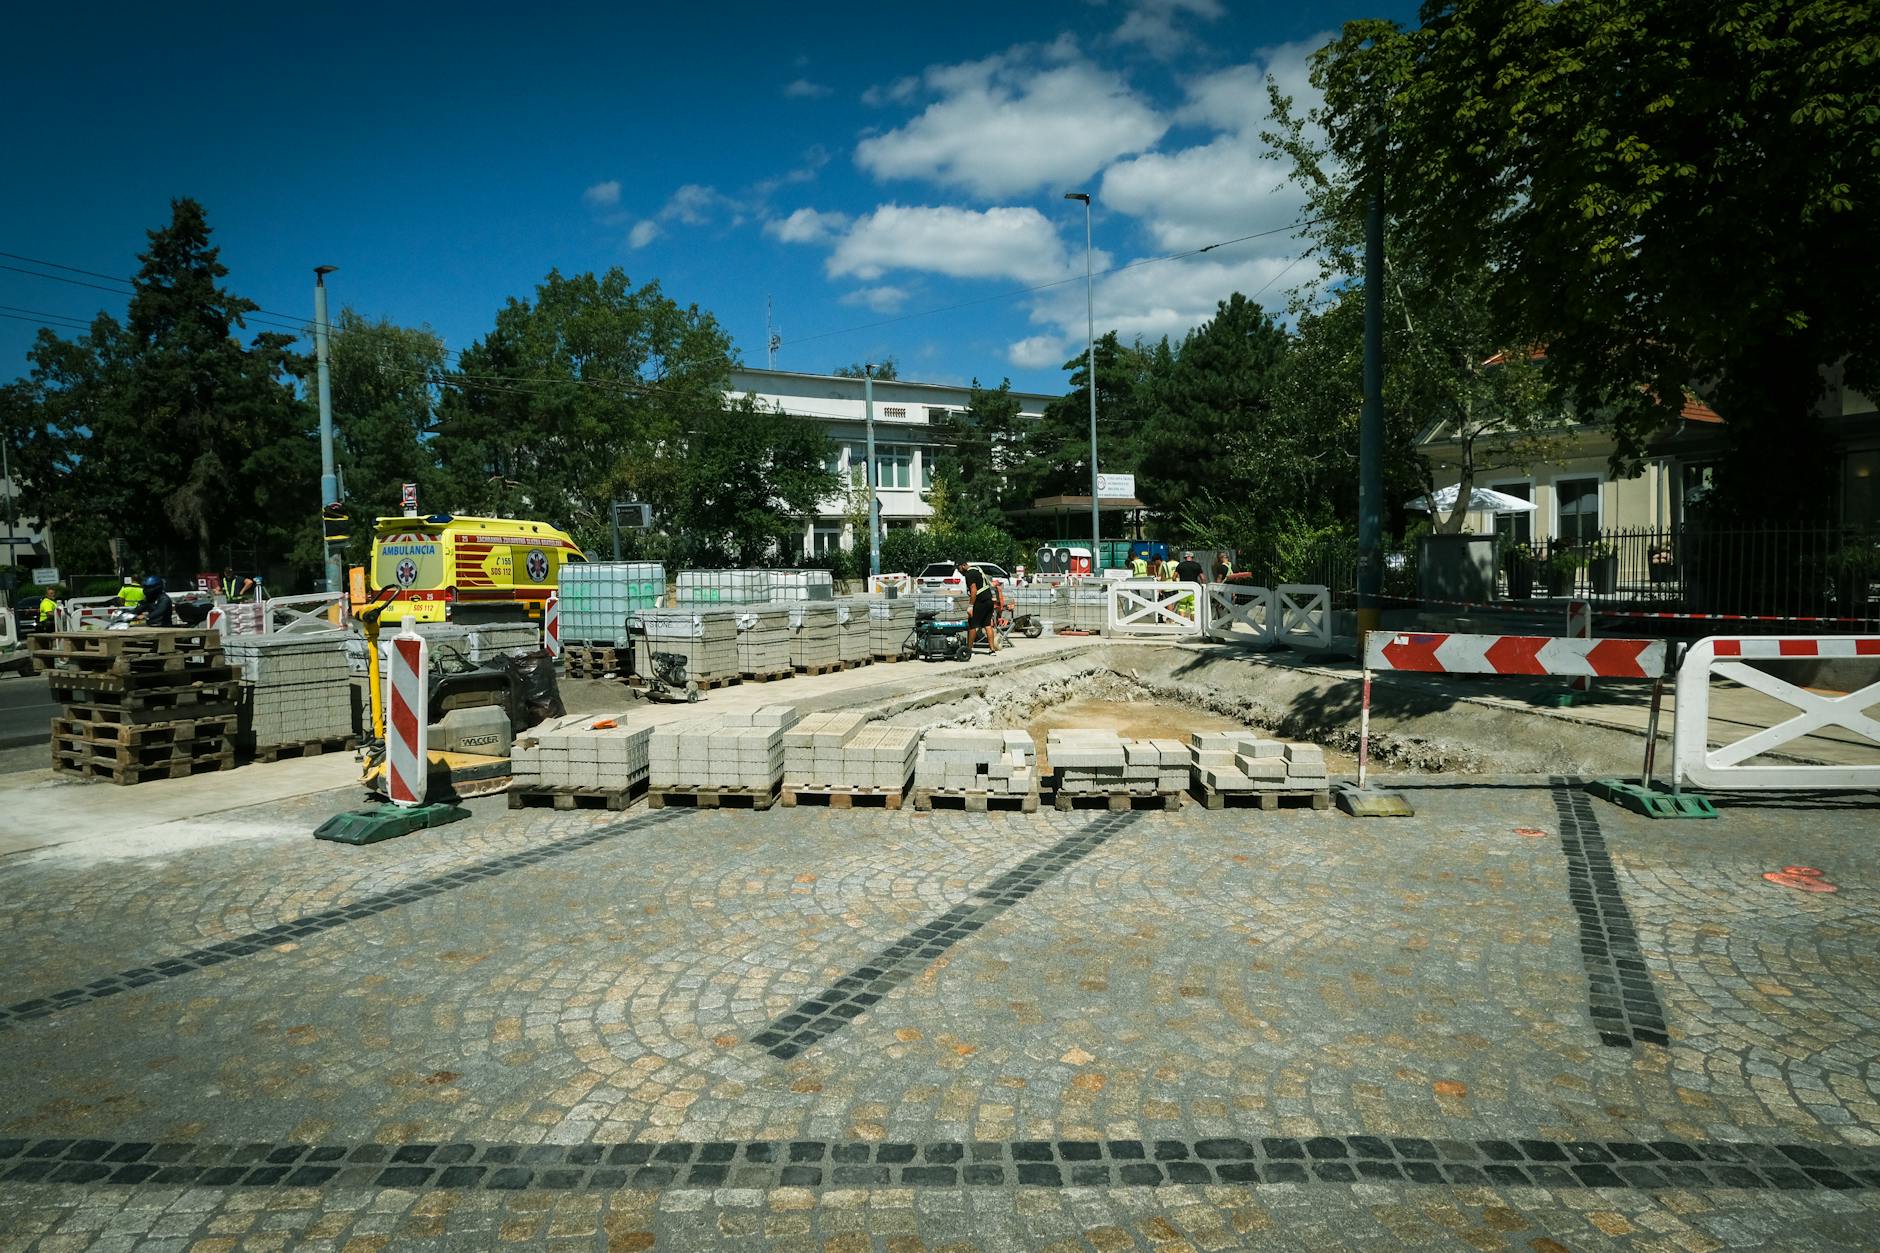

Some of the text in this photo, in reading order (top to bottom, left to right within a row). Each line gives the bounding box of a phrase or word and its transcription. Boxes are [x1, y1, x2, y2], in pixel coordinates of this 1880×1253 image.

[382, 545, 435, 556] AMBULANCIA
[502, 557, 512, 565] 155
[490, 567, 512, 576] SOS 112
[413, 604, 434, 612] SOS 112
